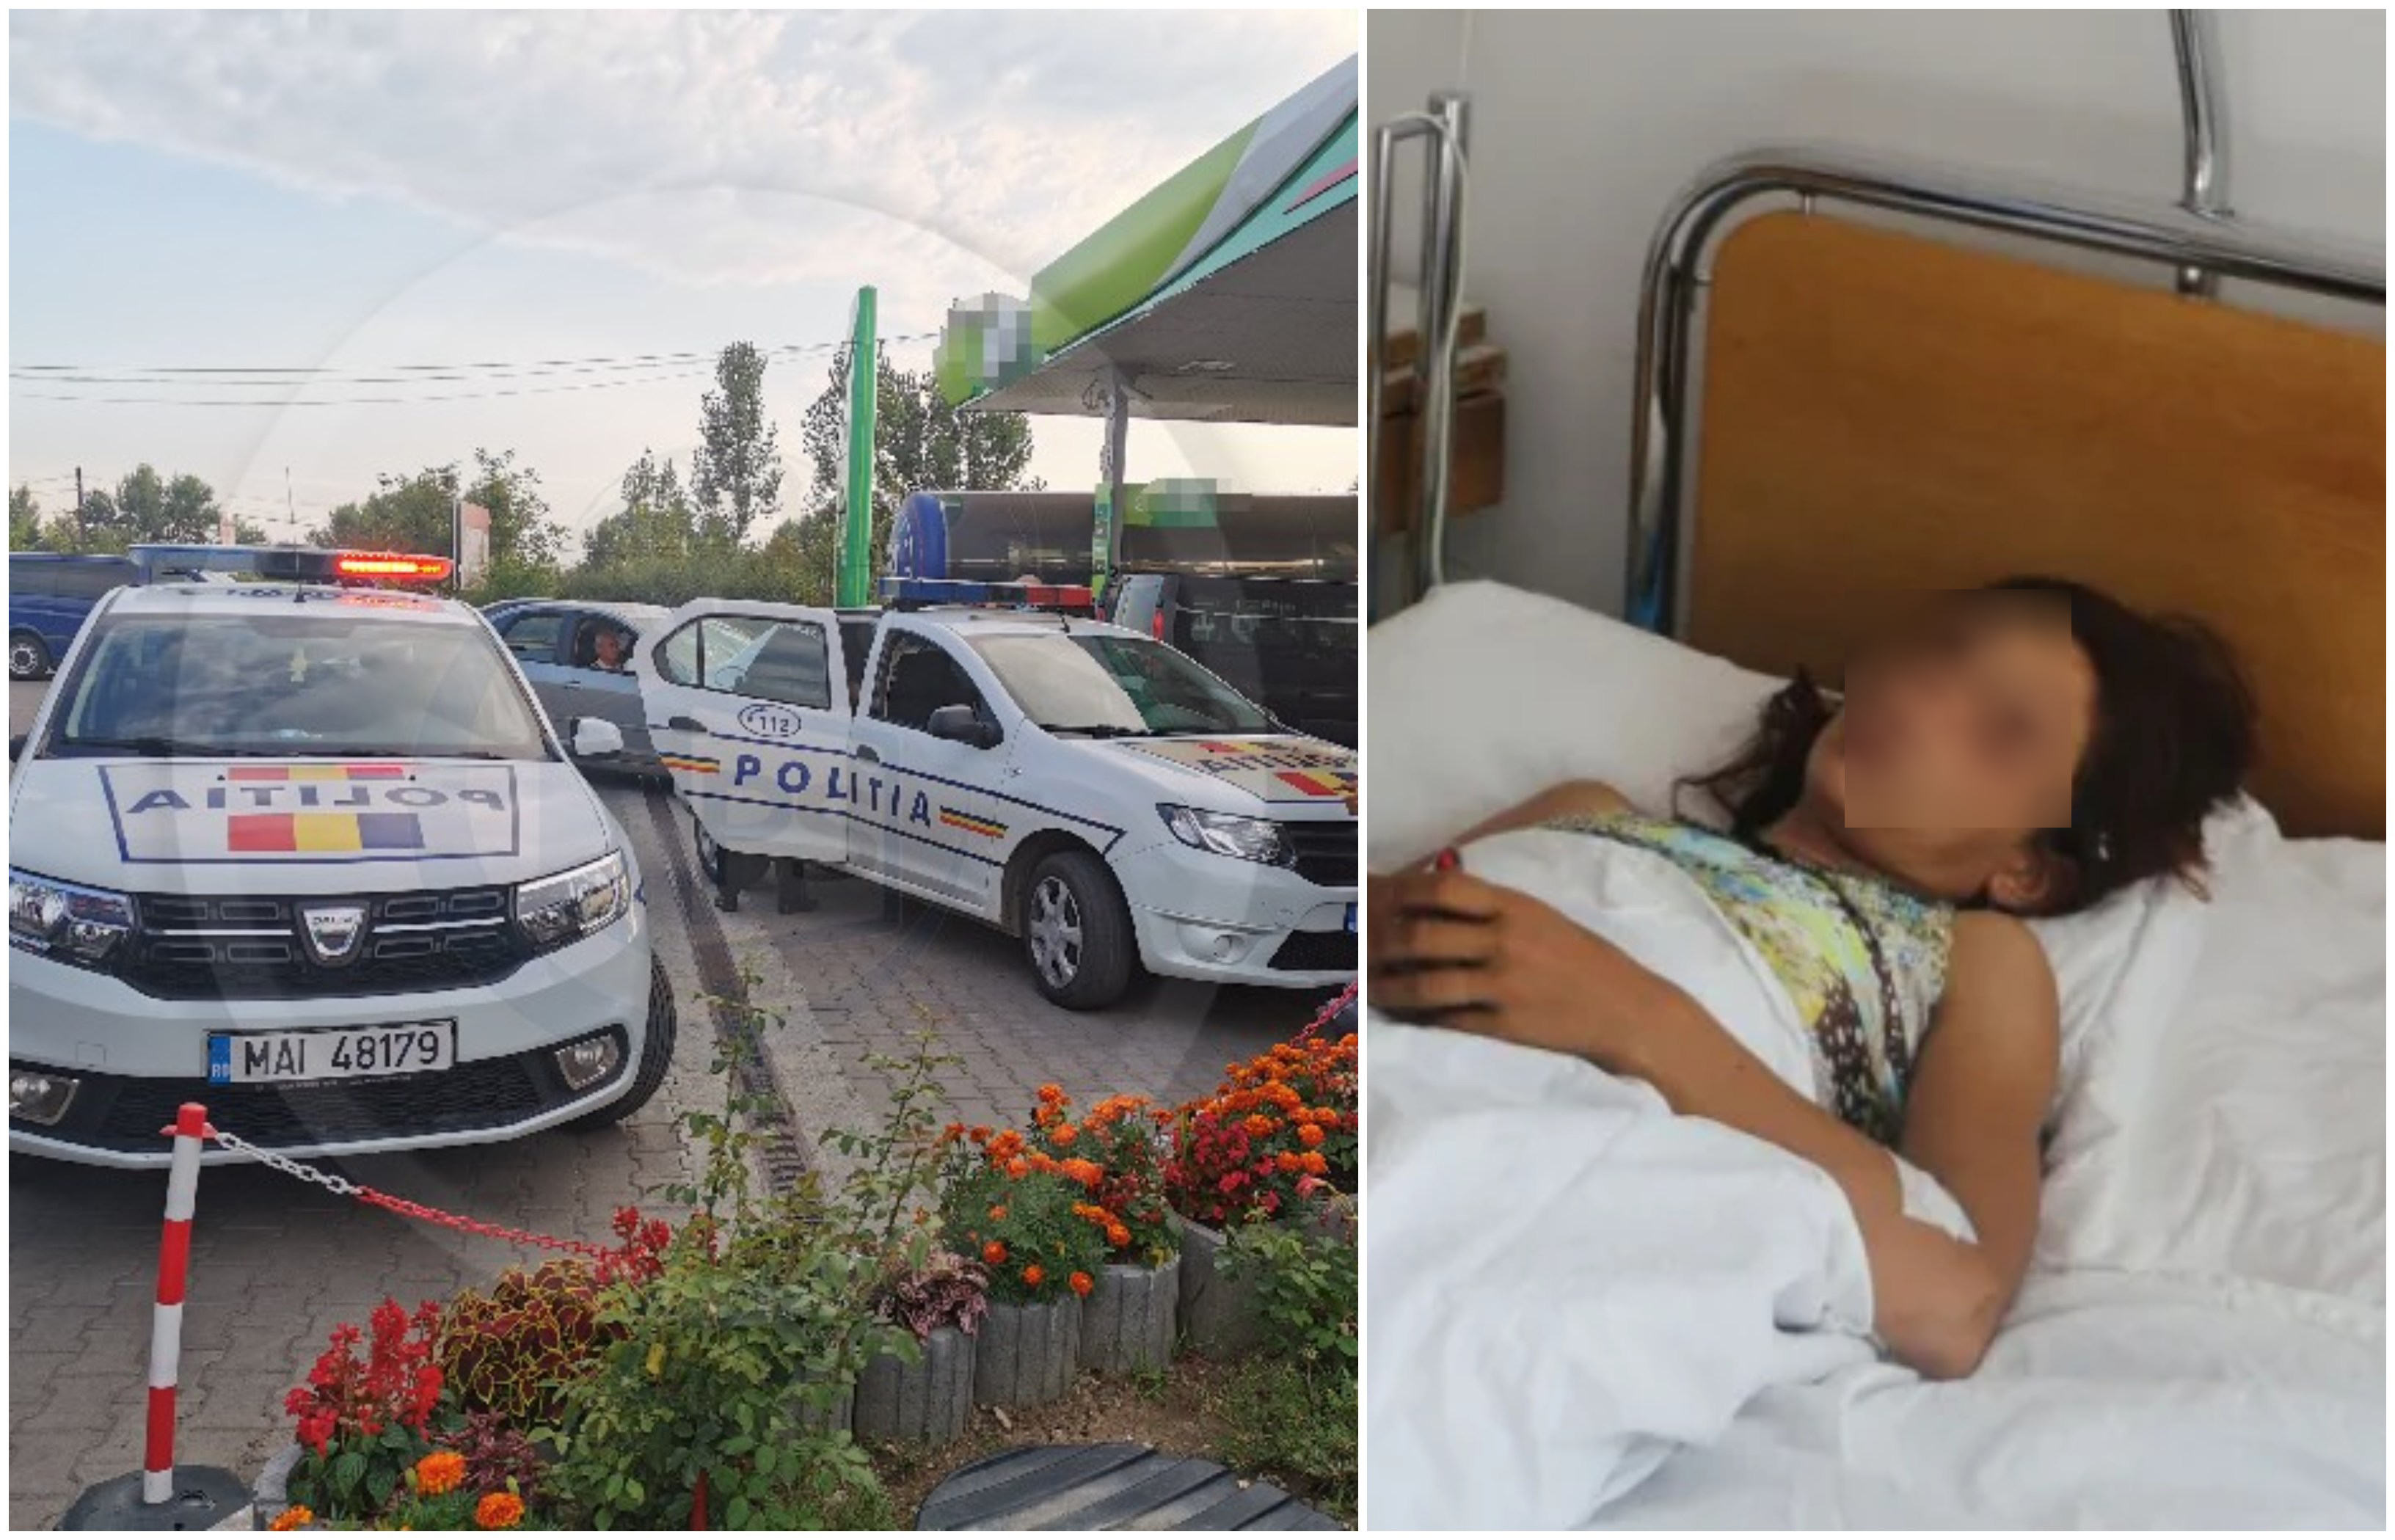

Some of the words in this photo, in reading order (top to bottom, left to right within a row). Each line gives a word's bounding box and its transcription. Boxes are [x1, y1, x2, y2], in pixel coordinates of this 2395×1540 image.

[759, 716, 789, 732] 112
[734, 754, 930, 828] POLITIA
[244, 1038, 305, 1076] MAI
[331, 1031, 439, 1070] 48179
